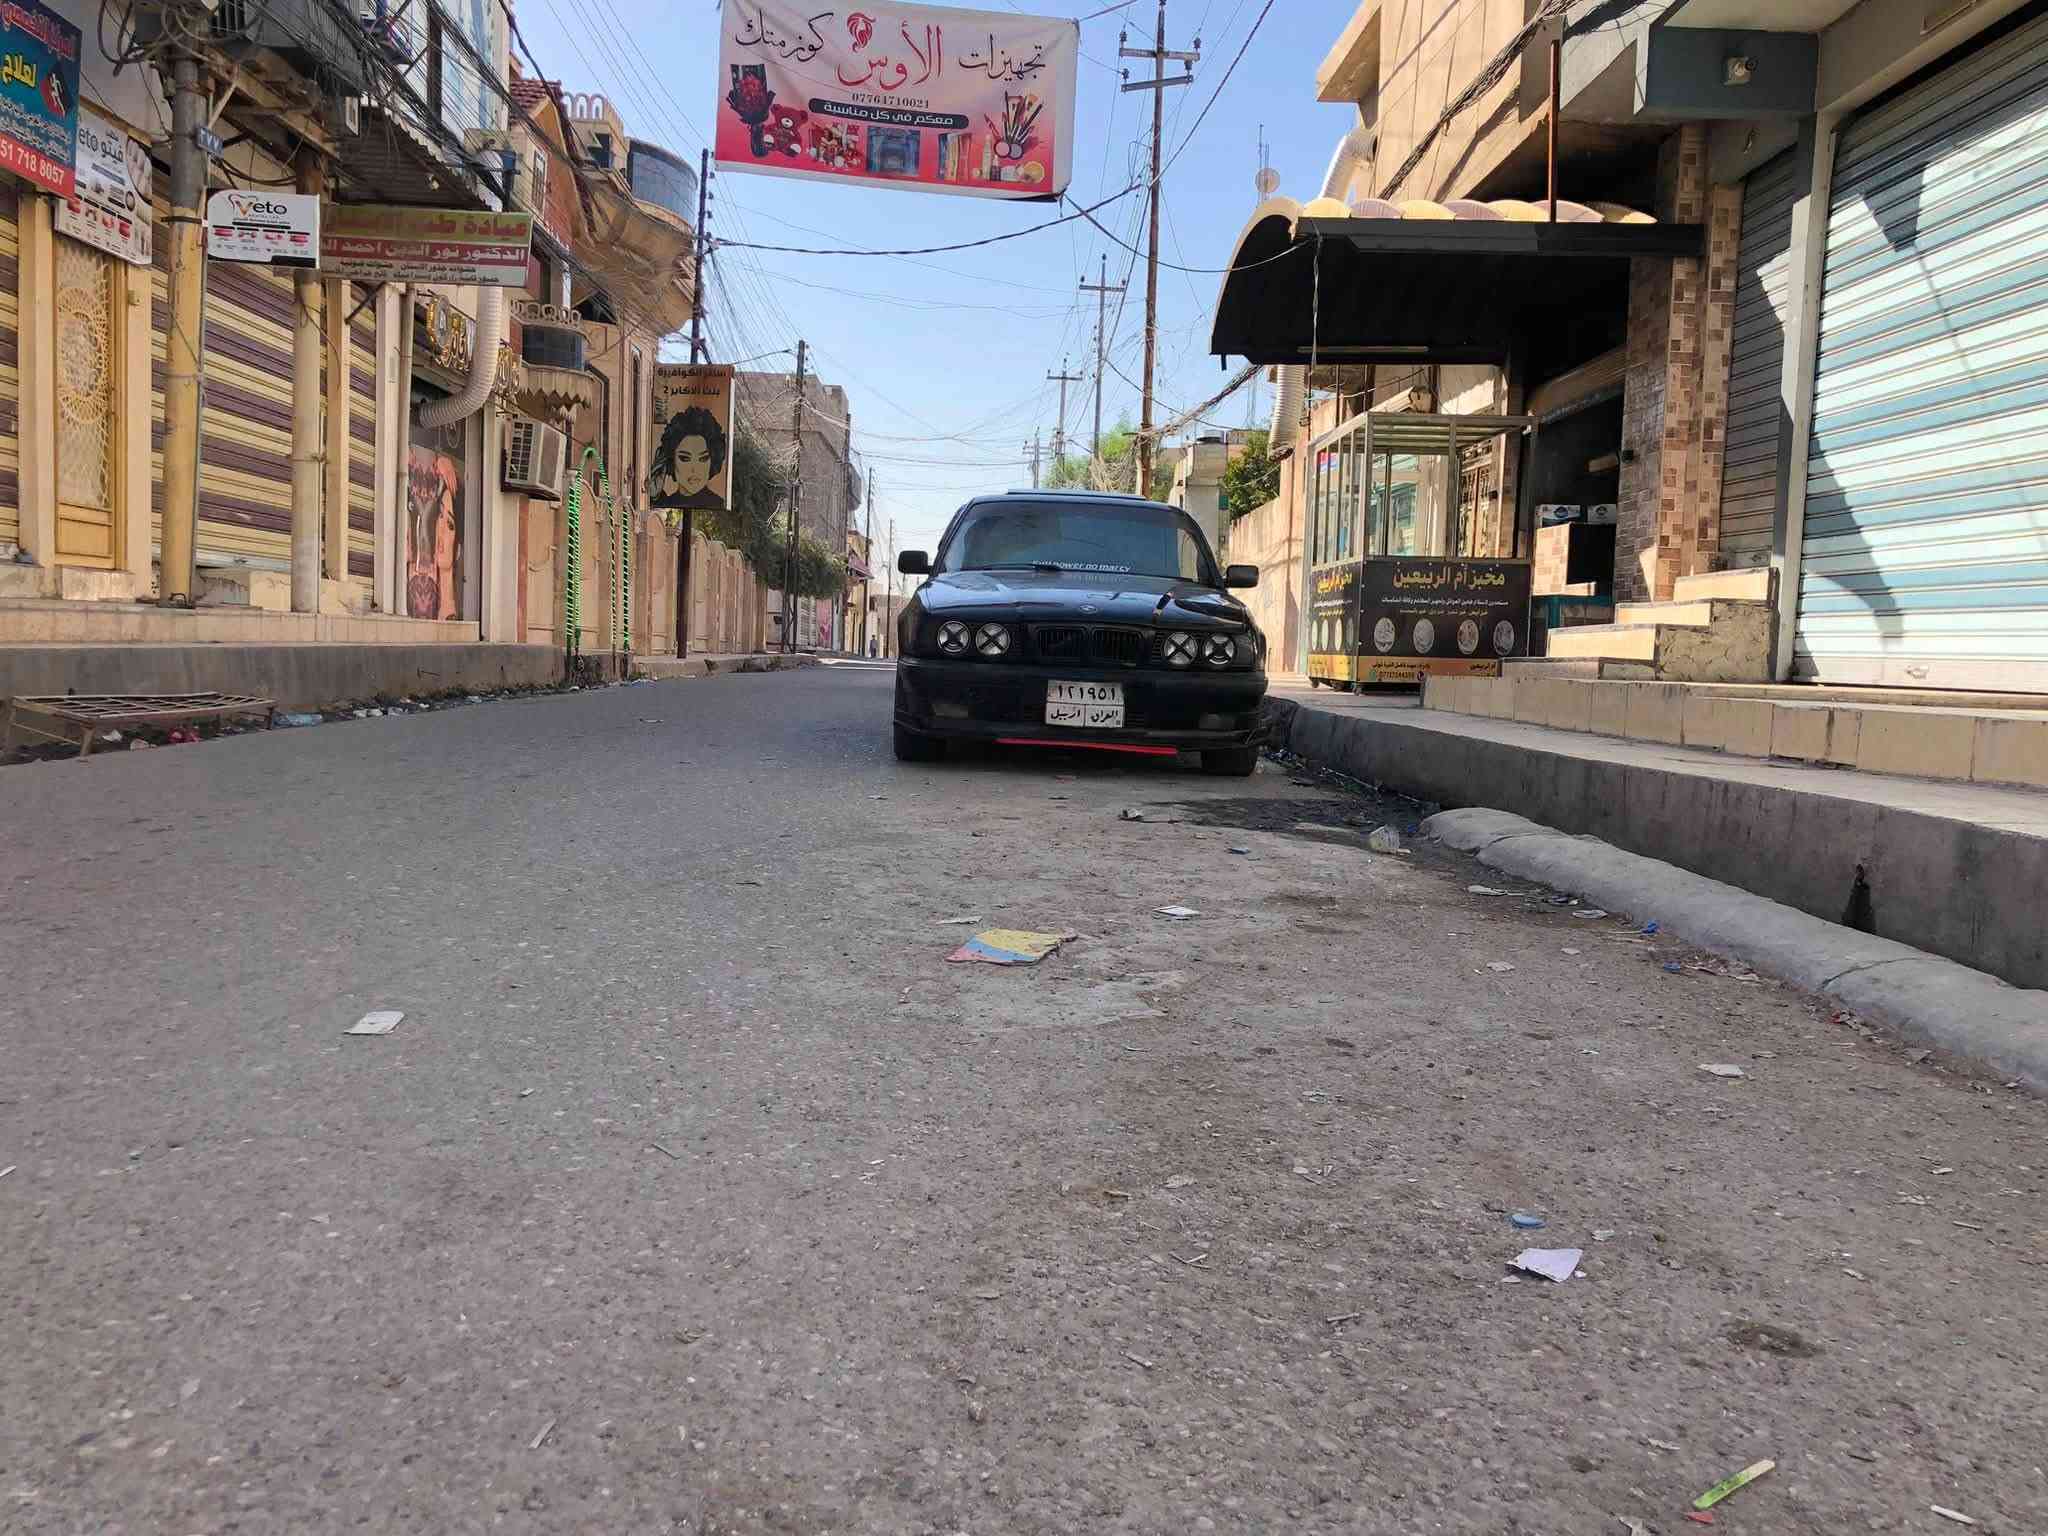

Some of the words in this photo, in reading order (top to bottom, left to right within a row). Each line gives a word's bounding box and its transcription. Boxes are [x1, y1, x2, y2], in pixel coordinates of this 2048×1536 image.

[958, 33, 1046, 81] تجهيزات
[823, 103, 869, 117] مناسبة
[870, 109, 891, 120] كل
[892, 111, 913, 122] في
[914, 115, 954, 125] معكم
[78, 126, 98, 153] eto
[16, 147, 37, 172] 718
[40, 159, 65, 185] 8057
[431, 243, 460, 260] نور
[463, 246, 525, 261] الدكتور
[663, 386, 669, 394] 2
[1393, 566, 1452, 589] الربيعين
[1468, 567, 1505, 590] مخبز
[1058, 685, 1116, 701] ١٢١٩٥١
[1050, 709, 1081, 721] اربيل
